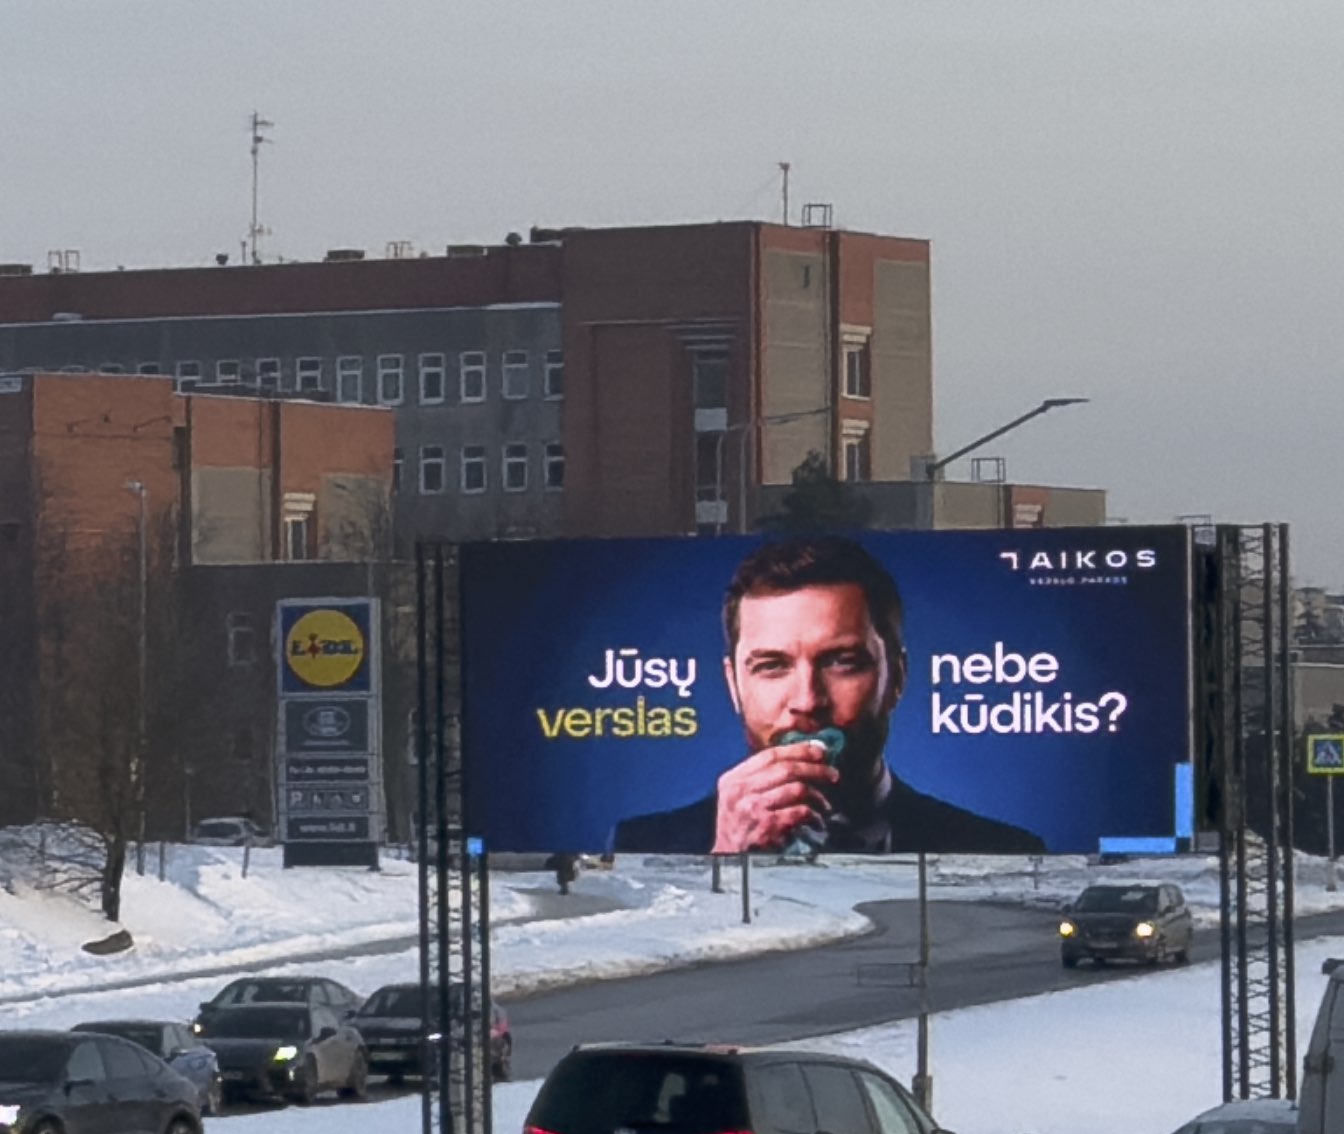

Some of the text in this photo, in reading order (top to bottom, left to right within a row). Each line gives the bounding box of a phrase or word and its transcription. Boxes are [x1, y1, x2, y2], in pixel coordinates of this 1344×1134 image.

[999, 549, 1157, 570] TAIKOS
[587, 648, 697, 698] Jūsų
[931, 641, 1059, 684] nebe
[536, 695, 698, 738] verslas
[931, 690, 1128, 734] kūdikis?
